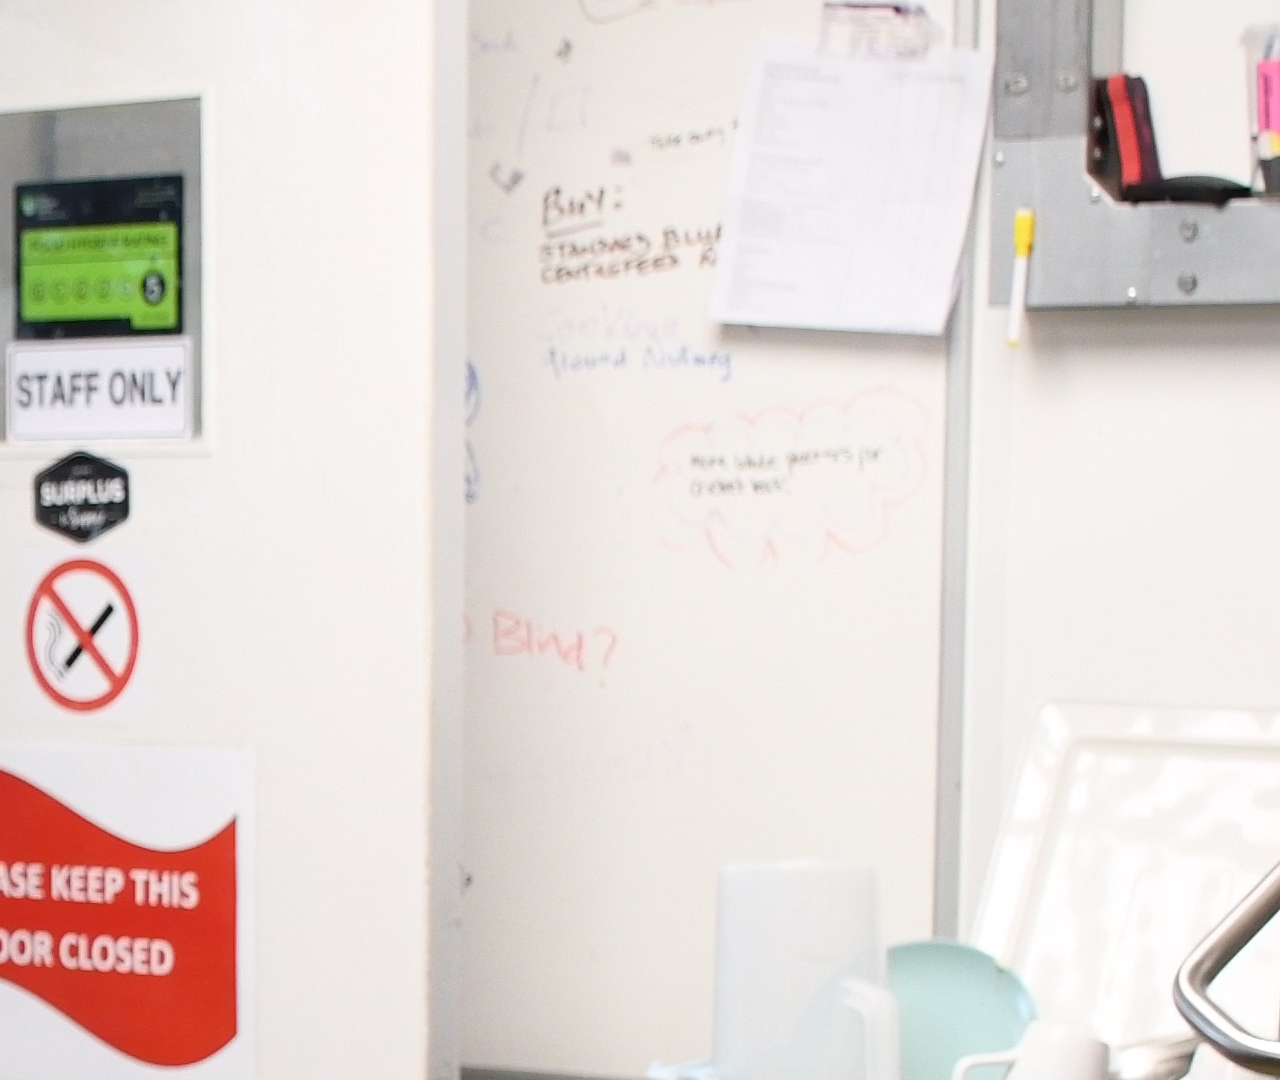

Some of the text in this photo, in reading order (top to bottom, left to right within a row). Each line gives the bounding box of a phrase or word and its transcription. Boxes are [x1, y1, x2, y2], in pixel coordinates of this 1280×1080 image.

[17, 370, 182, 409] STAFF ONLY
[40, 477, 127, 507] SURPLUS
[51, 863, 125, 905] KEEP
[128, 867, 201, 910] THIS
[58, 931, 175, 976] CLOSED
